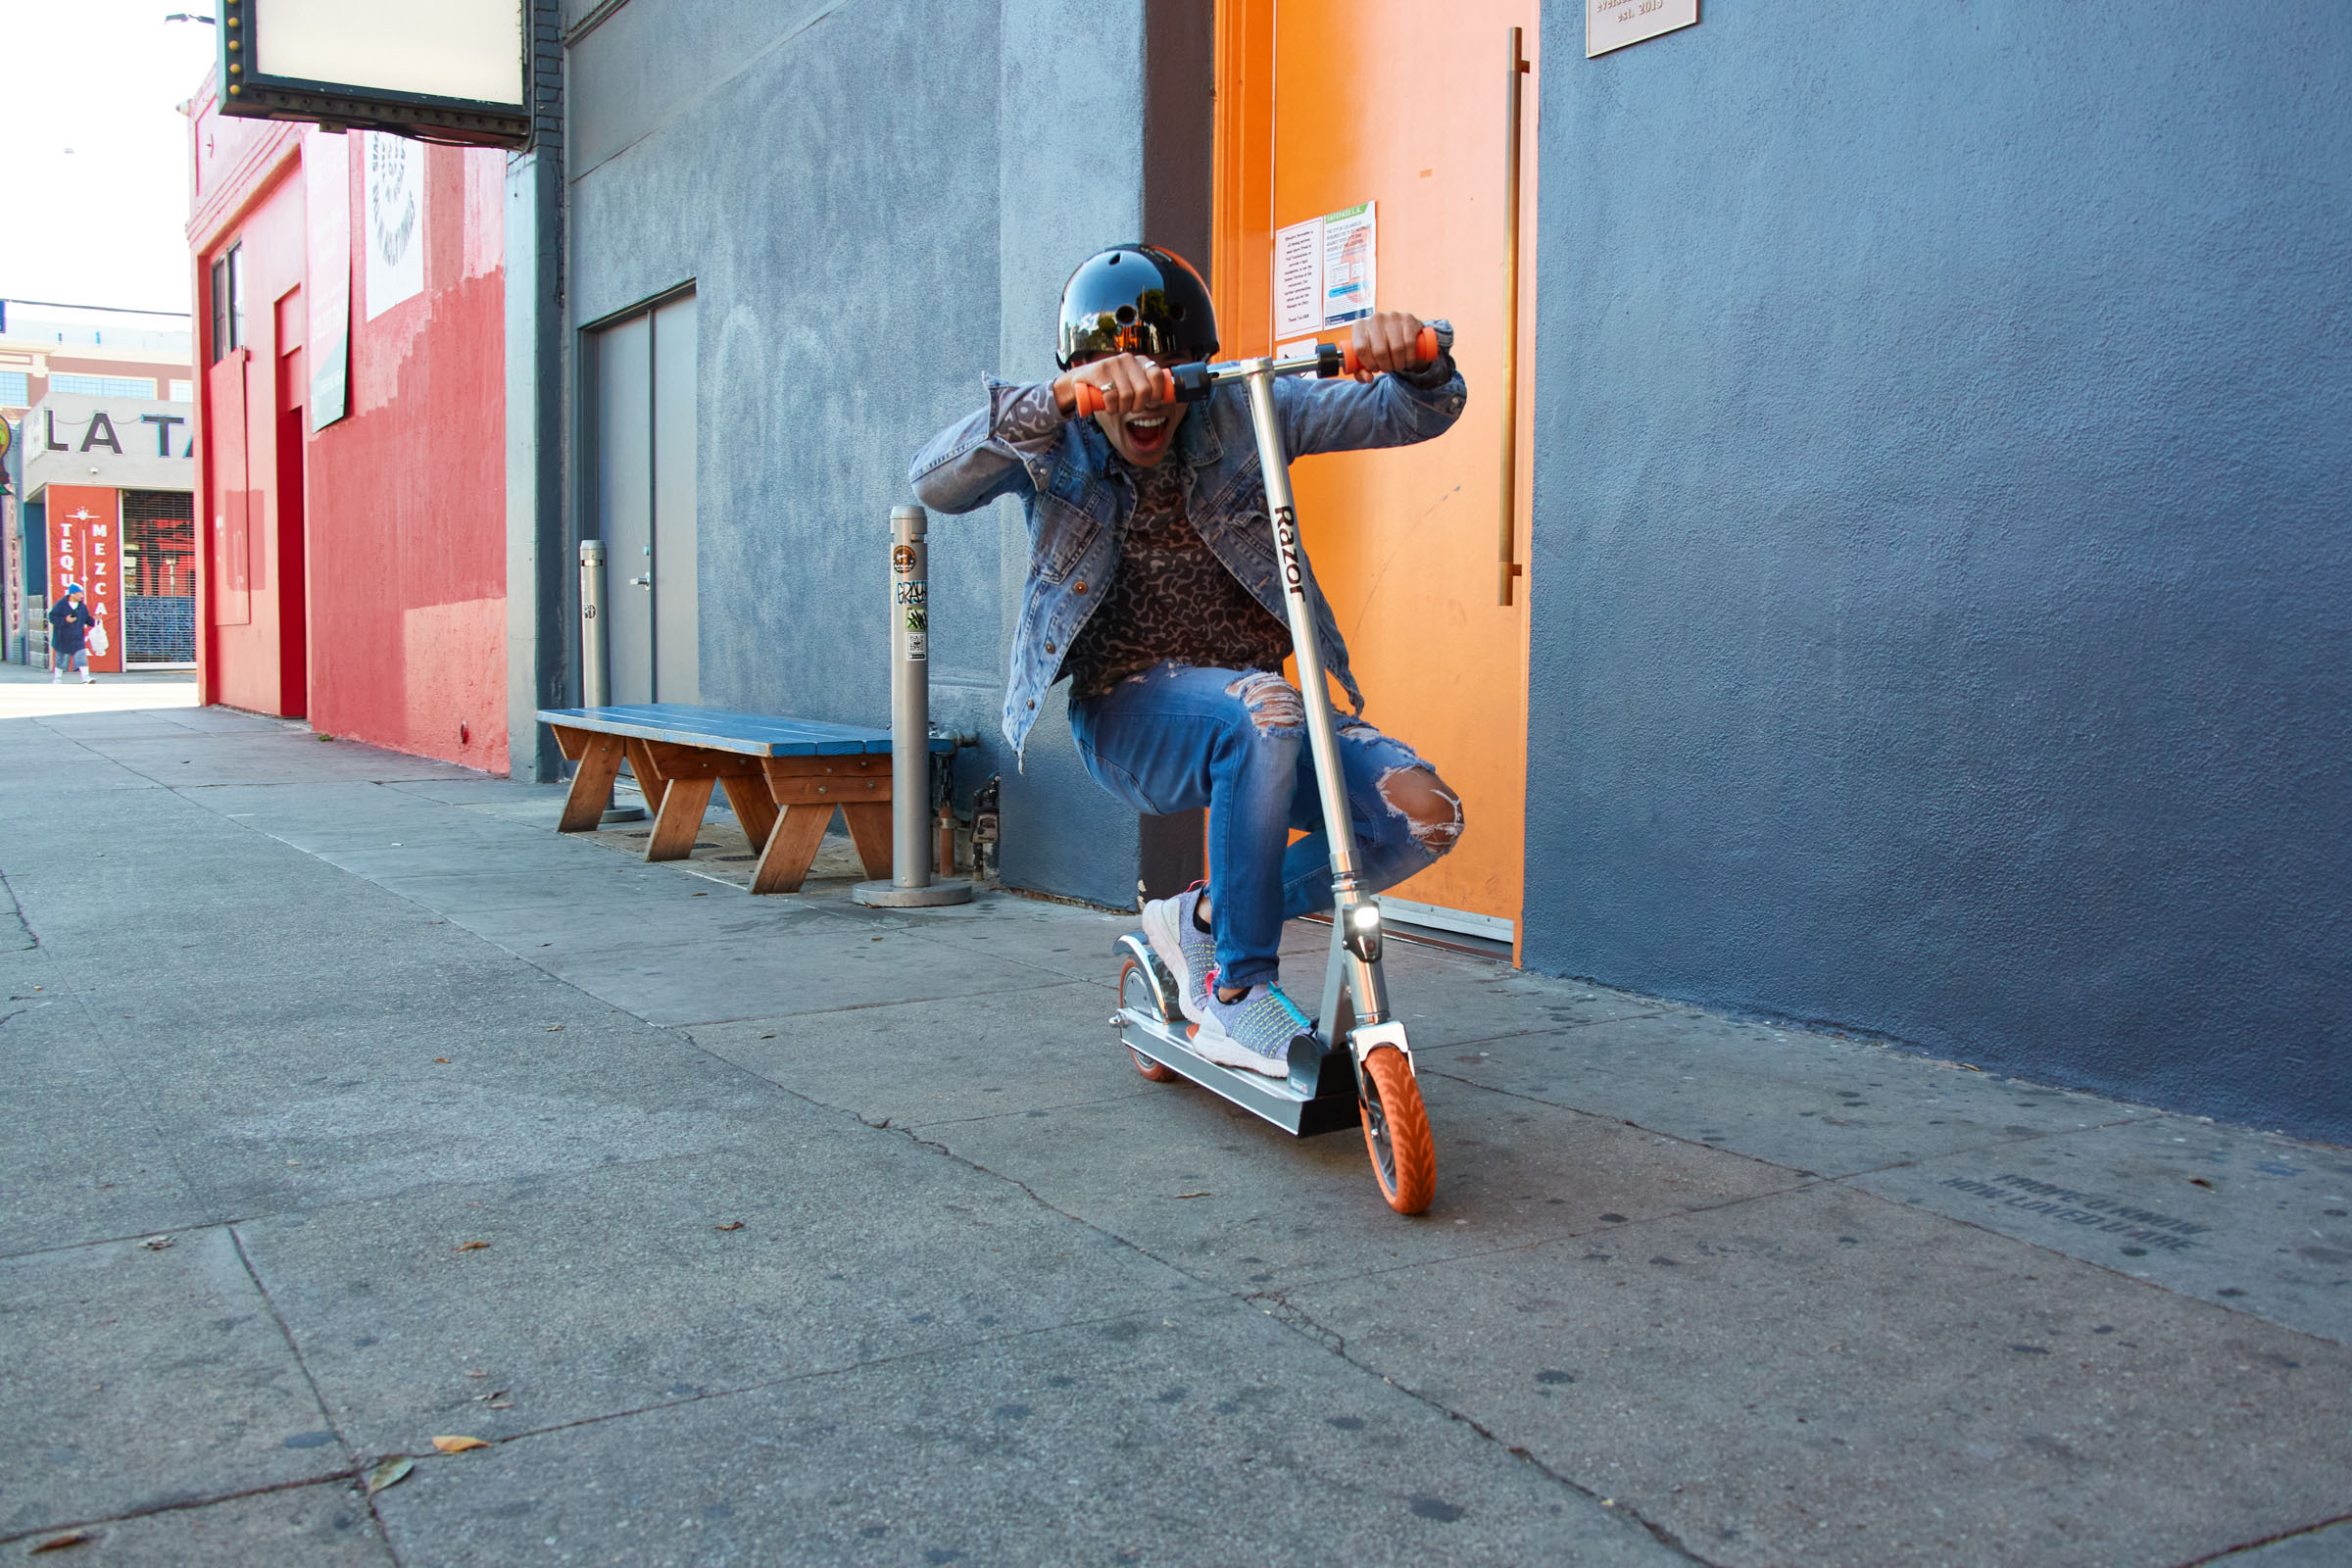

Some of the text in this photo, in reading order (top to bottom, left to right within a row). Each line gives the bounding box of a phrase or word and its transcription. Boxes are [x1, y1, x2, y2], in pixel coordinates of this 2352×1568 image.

[44, 409, 194, 459] LA T
[1938, 1177, 2015, 1199] HOW
[2003, 1196, 2106, 1225] LOVED
